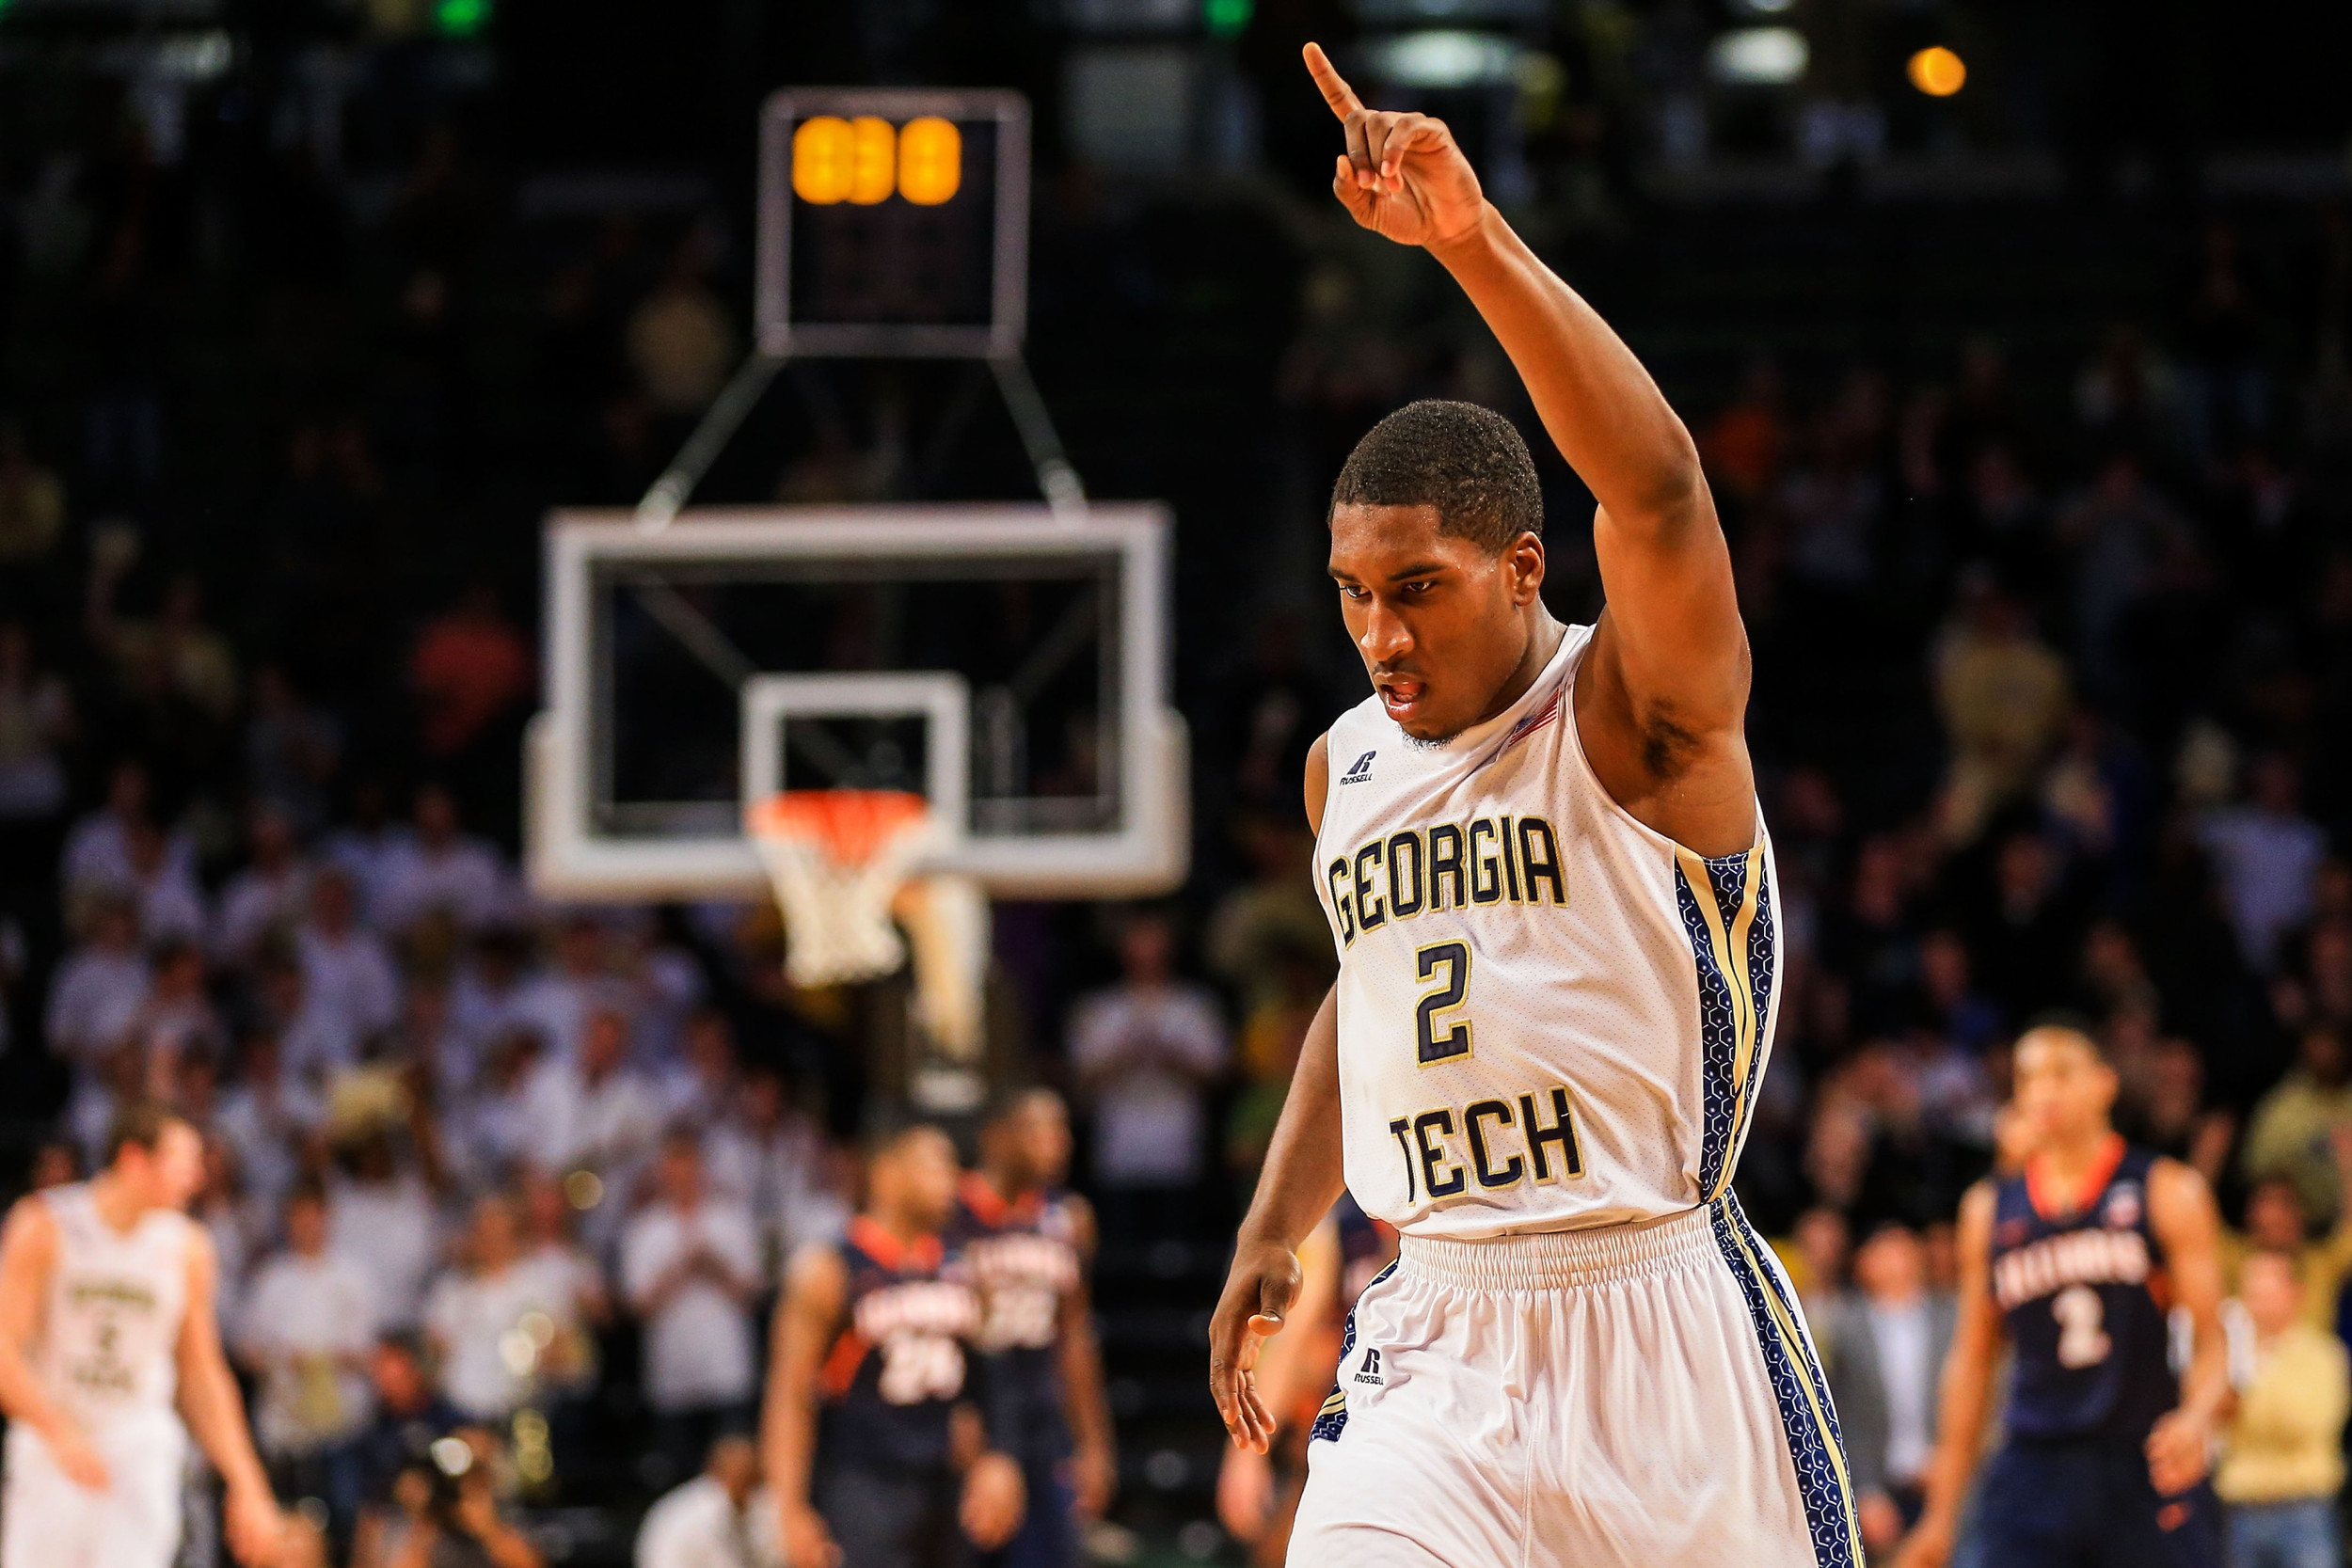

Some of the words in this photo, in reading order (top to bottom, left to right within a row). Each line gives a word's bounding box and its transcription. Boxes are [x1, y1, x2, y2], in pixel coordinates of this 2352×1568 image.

[1339, 772, 1373, 786] RUSSELL
[1327, 815, 1568, 950] GEORGIA
[1414, 938, 1474, 1069] 2
[1390, 1086, 1586, 1207] TECH
[1354, 1373, 1384, 1386] RUSSELL
